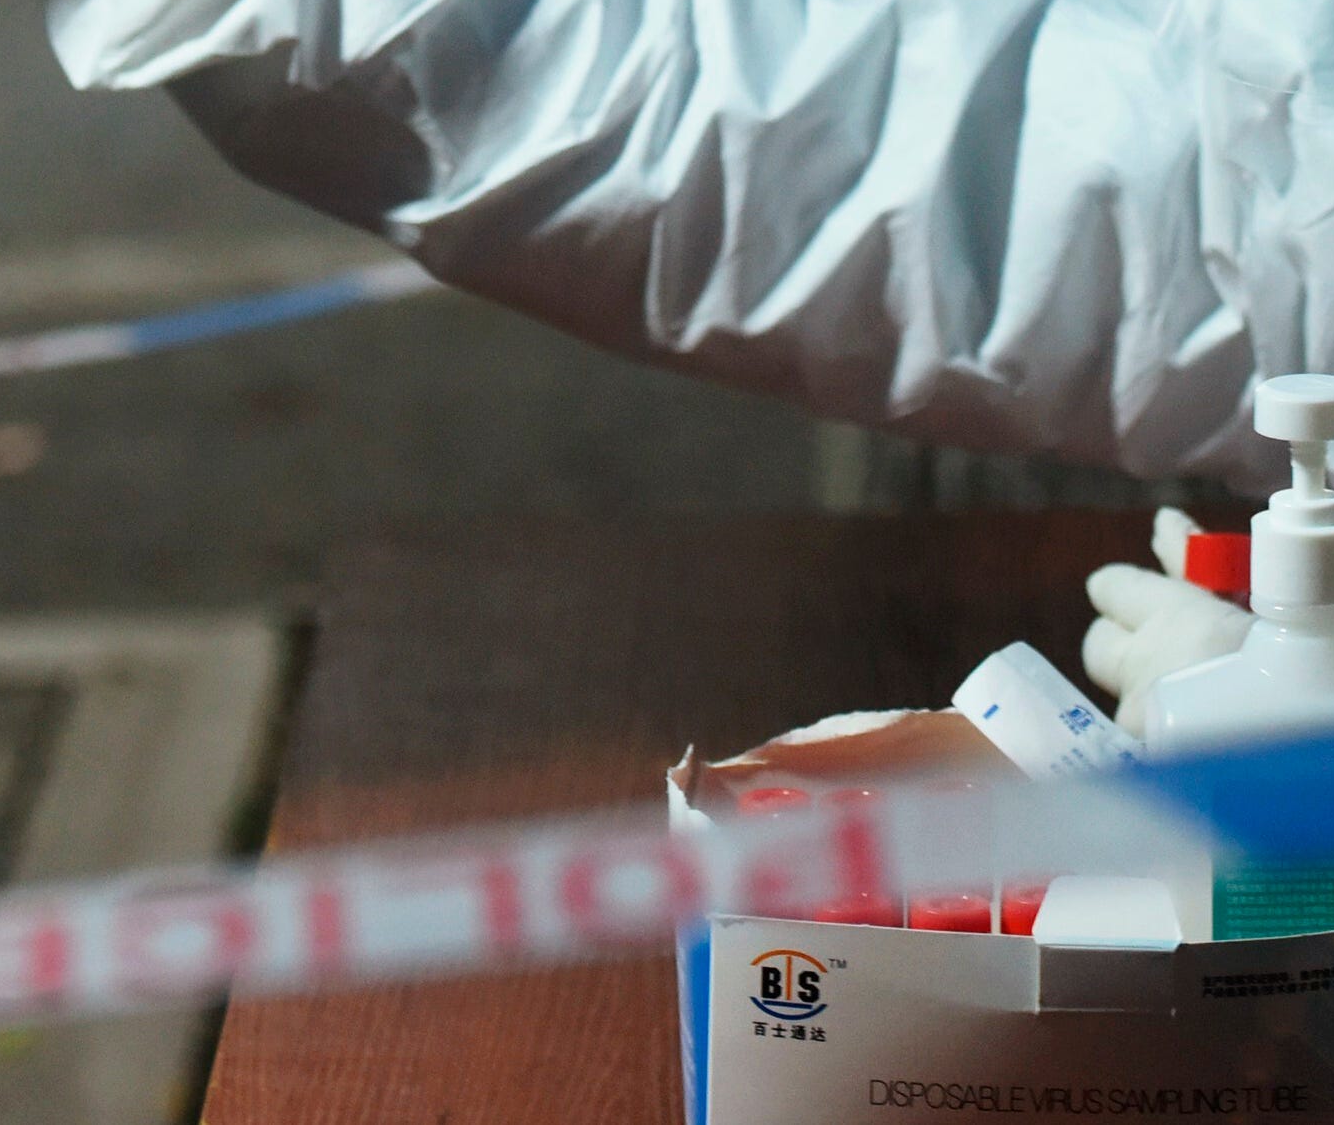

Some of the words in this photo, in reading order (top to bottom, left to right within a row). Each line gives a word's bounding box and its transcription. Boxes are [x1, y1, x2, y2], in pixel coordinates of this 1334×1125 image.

[752, 1021, 827, 1043] 百士通达
[869, 1079, 1027, 1113] DISPOSABLE
[1029, 1087, 1105, 1115] VIRUS
[1107, 1087, 1238, 1115] SAMPLING
[1240, 1085, 1309, 1114] TUBE
